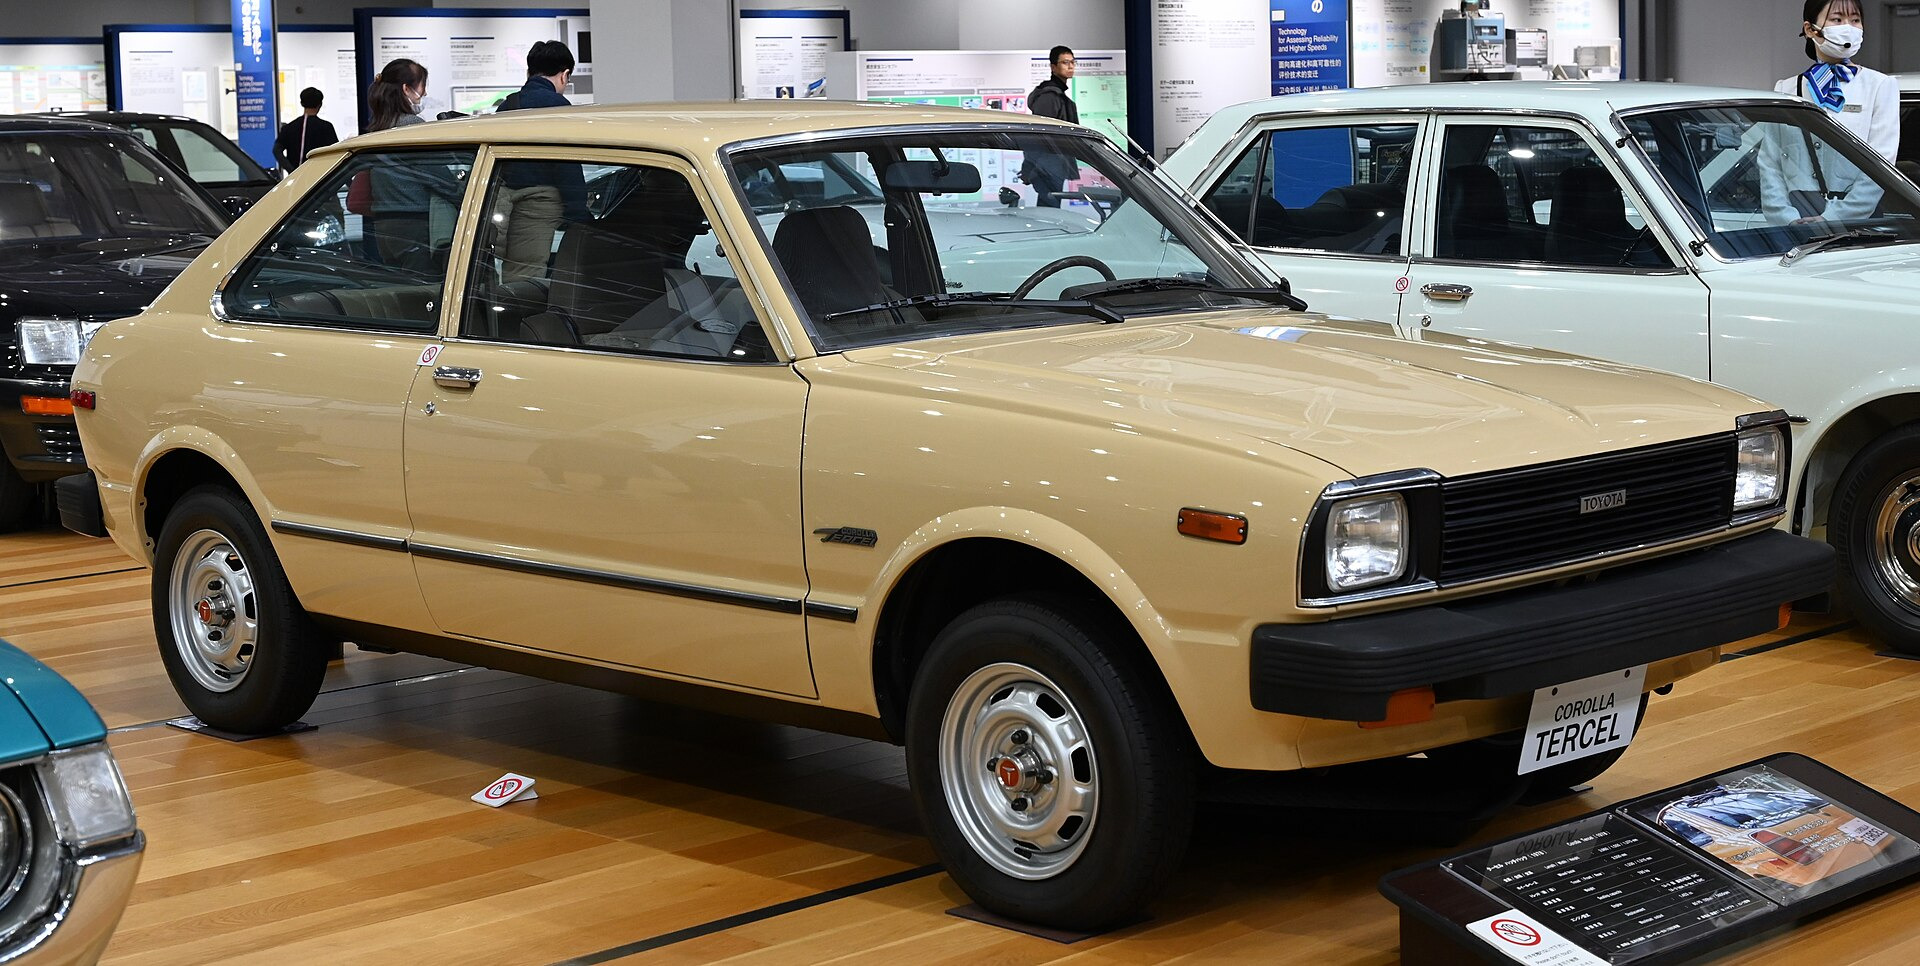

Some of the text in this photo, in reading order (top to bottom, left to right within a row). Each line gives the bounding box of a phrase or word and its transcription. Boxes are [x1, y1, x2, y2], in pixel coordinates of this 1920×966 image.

[1312, 0, 1323, 13] の
[1278, 28, 1307, 36] Technology
[1313, 35, 1338, 43] Reliability
[1289, 44, 1306, 53] Higher
[1307, 44, 1327, 52] Speeds
[1584, 492, 1623, 511] TOYOTA
[1555, 692, 1614, 722] COROLLA
[1536, 713, 1620, 761] TERCEL
